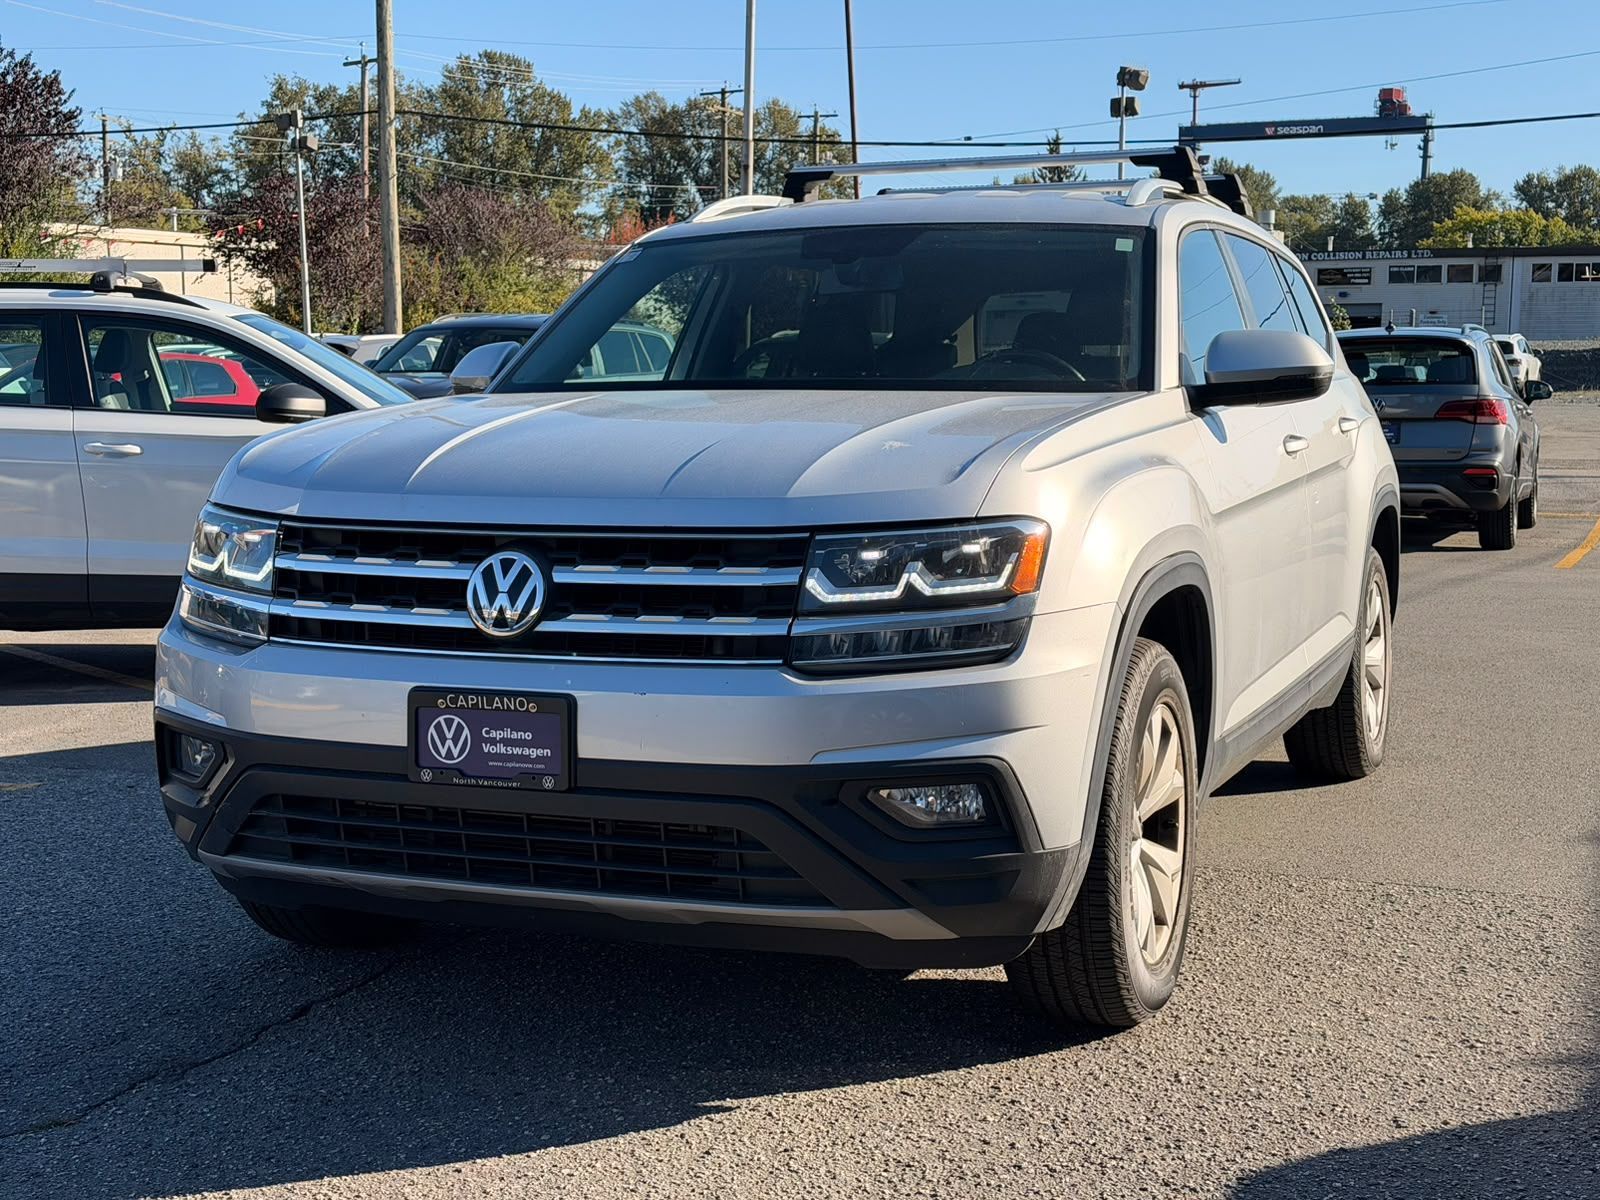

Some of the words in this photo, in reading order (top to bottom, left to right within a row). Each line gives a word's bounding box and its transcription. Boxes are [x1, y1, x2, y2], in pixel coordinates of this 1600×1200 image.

[1276, 125, 1323, 135] seaspan
[1311, 251, 1362, 260] COLLISION
[1365, 250, 1408, 259] REPAIRS
[1411, 249, 1434, 258] LTD.
[446, 694, 528, 711] CAPILANO
[428, 714, 471, 764] VW
[482, 727, 533, 741] Capilano
[482, 743, 551, 758] Volkswagen
[488, 760, 545, 769] www.capilanovw.com
[453, 777, 476, 785] North
[478, 778, 521, 788] Vancouver
